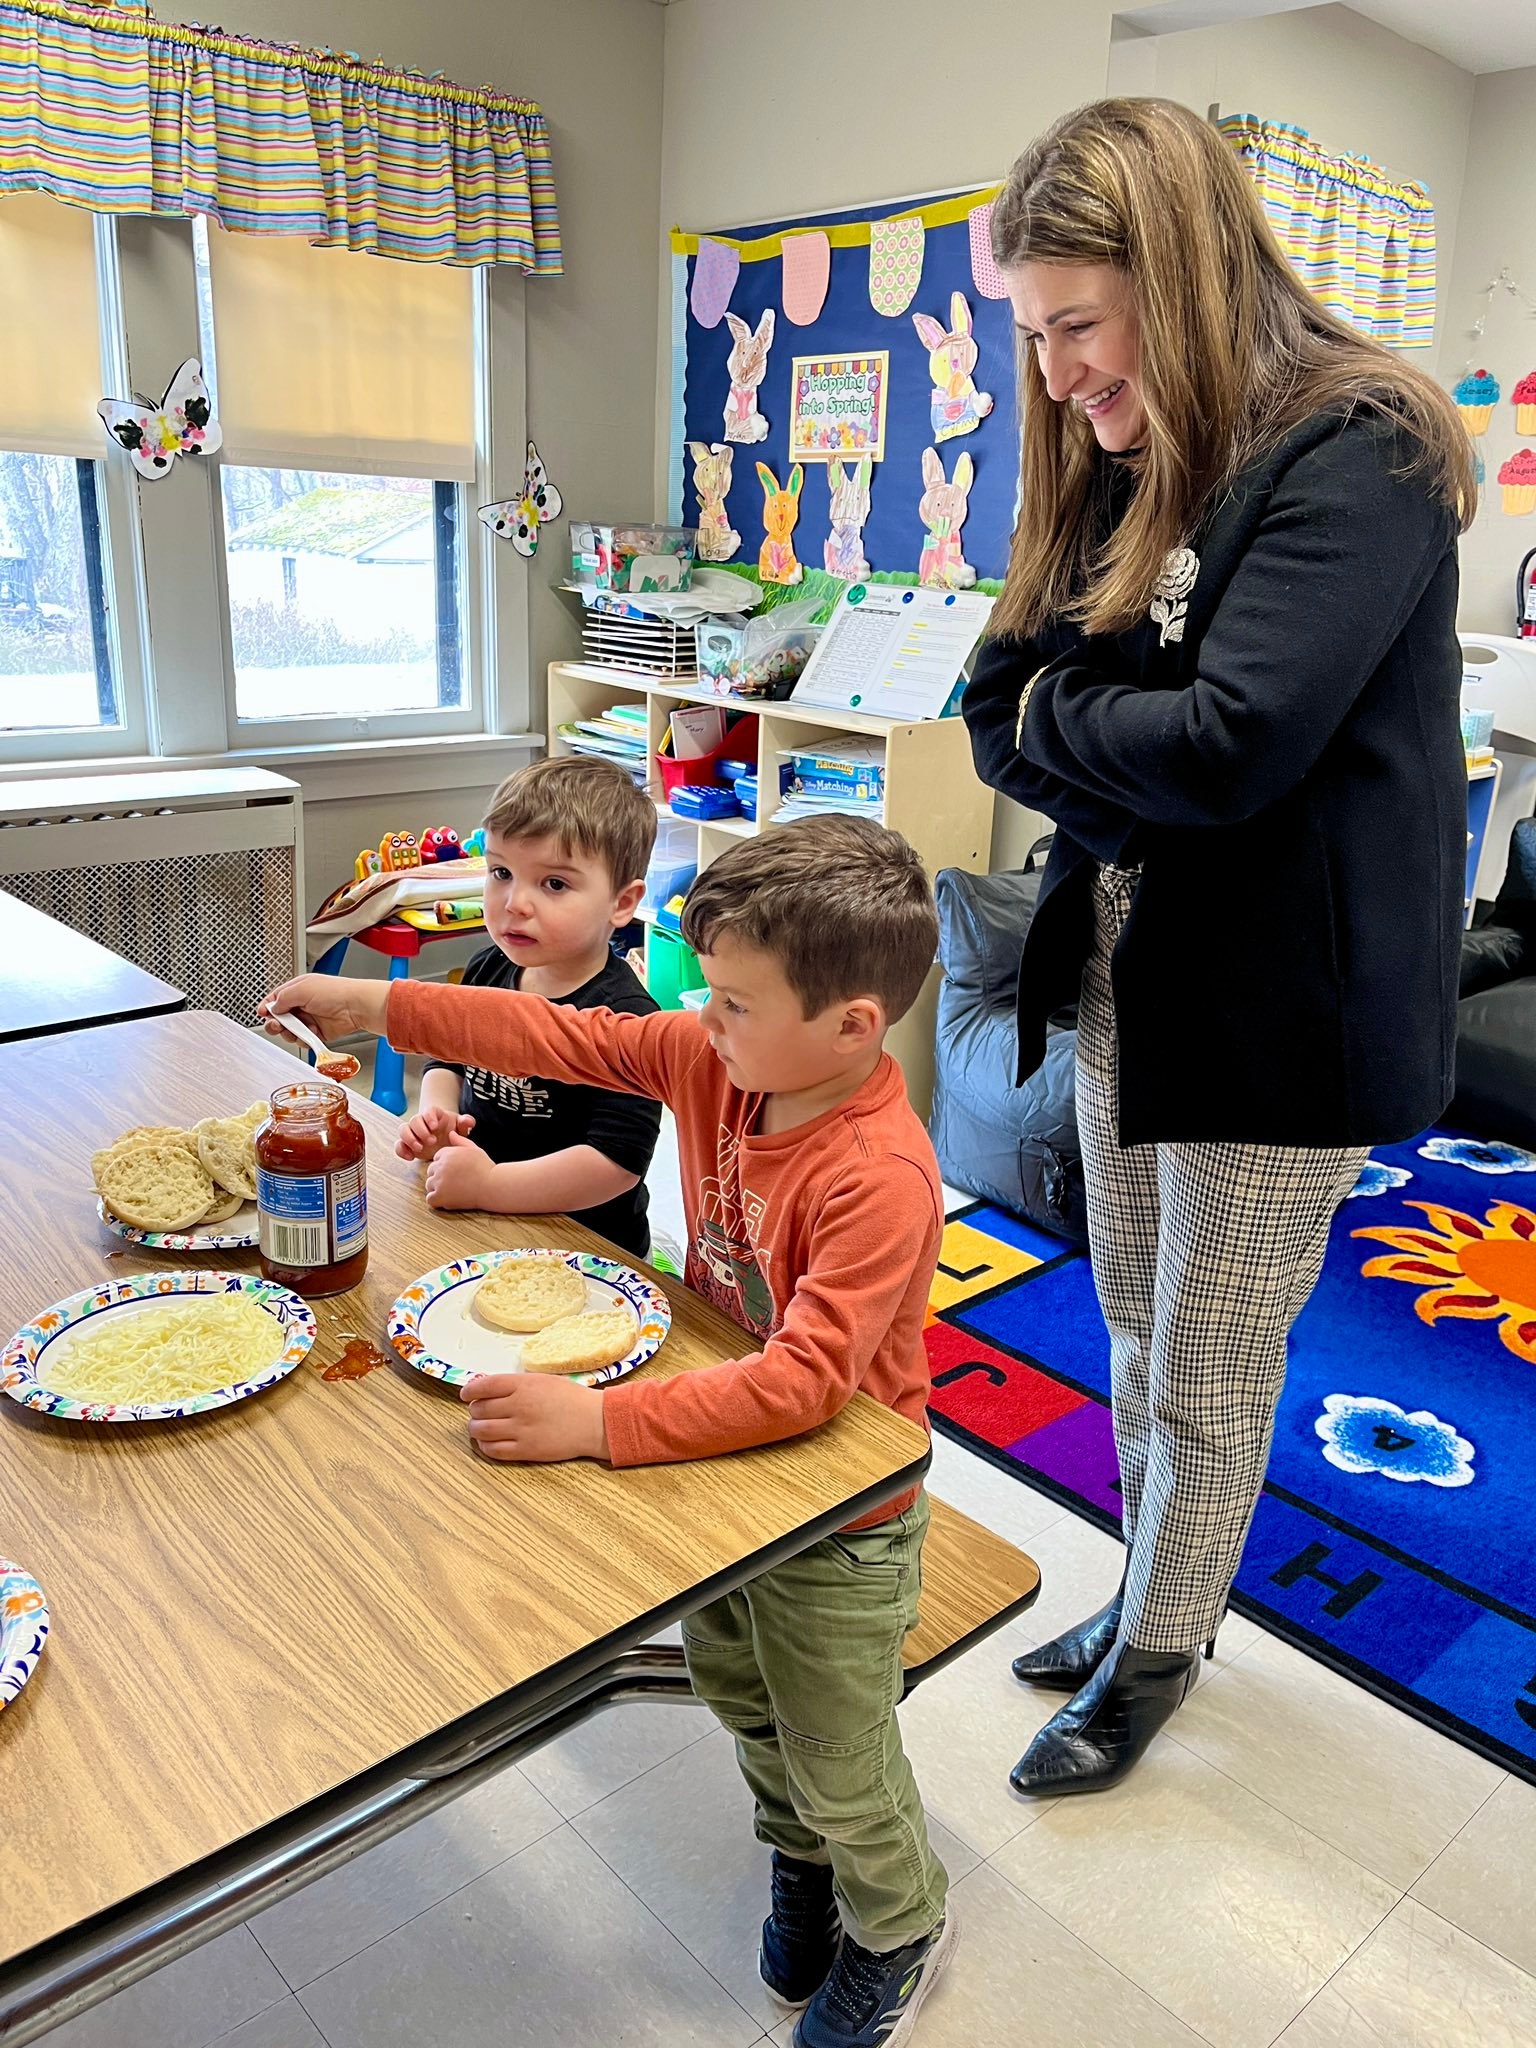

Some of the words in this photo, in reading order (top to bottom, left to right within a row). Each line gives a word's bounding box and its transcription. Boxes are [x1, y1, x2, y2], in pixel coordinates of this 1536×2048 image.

[810, 373, 866, 395] Hopping
[798, 398, 825, 415] into
[827, 394, 876, 418] Spring!
[816, 780, 854, 796] Matching
[930, 1361, 1007, 1388] J
[1372, 1425, 1416, 1451] 4
[1268, 1541, 1384, 1620] H
